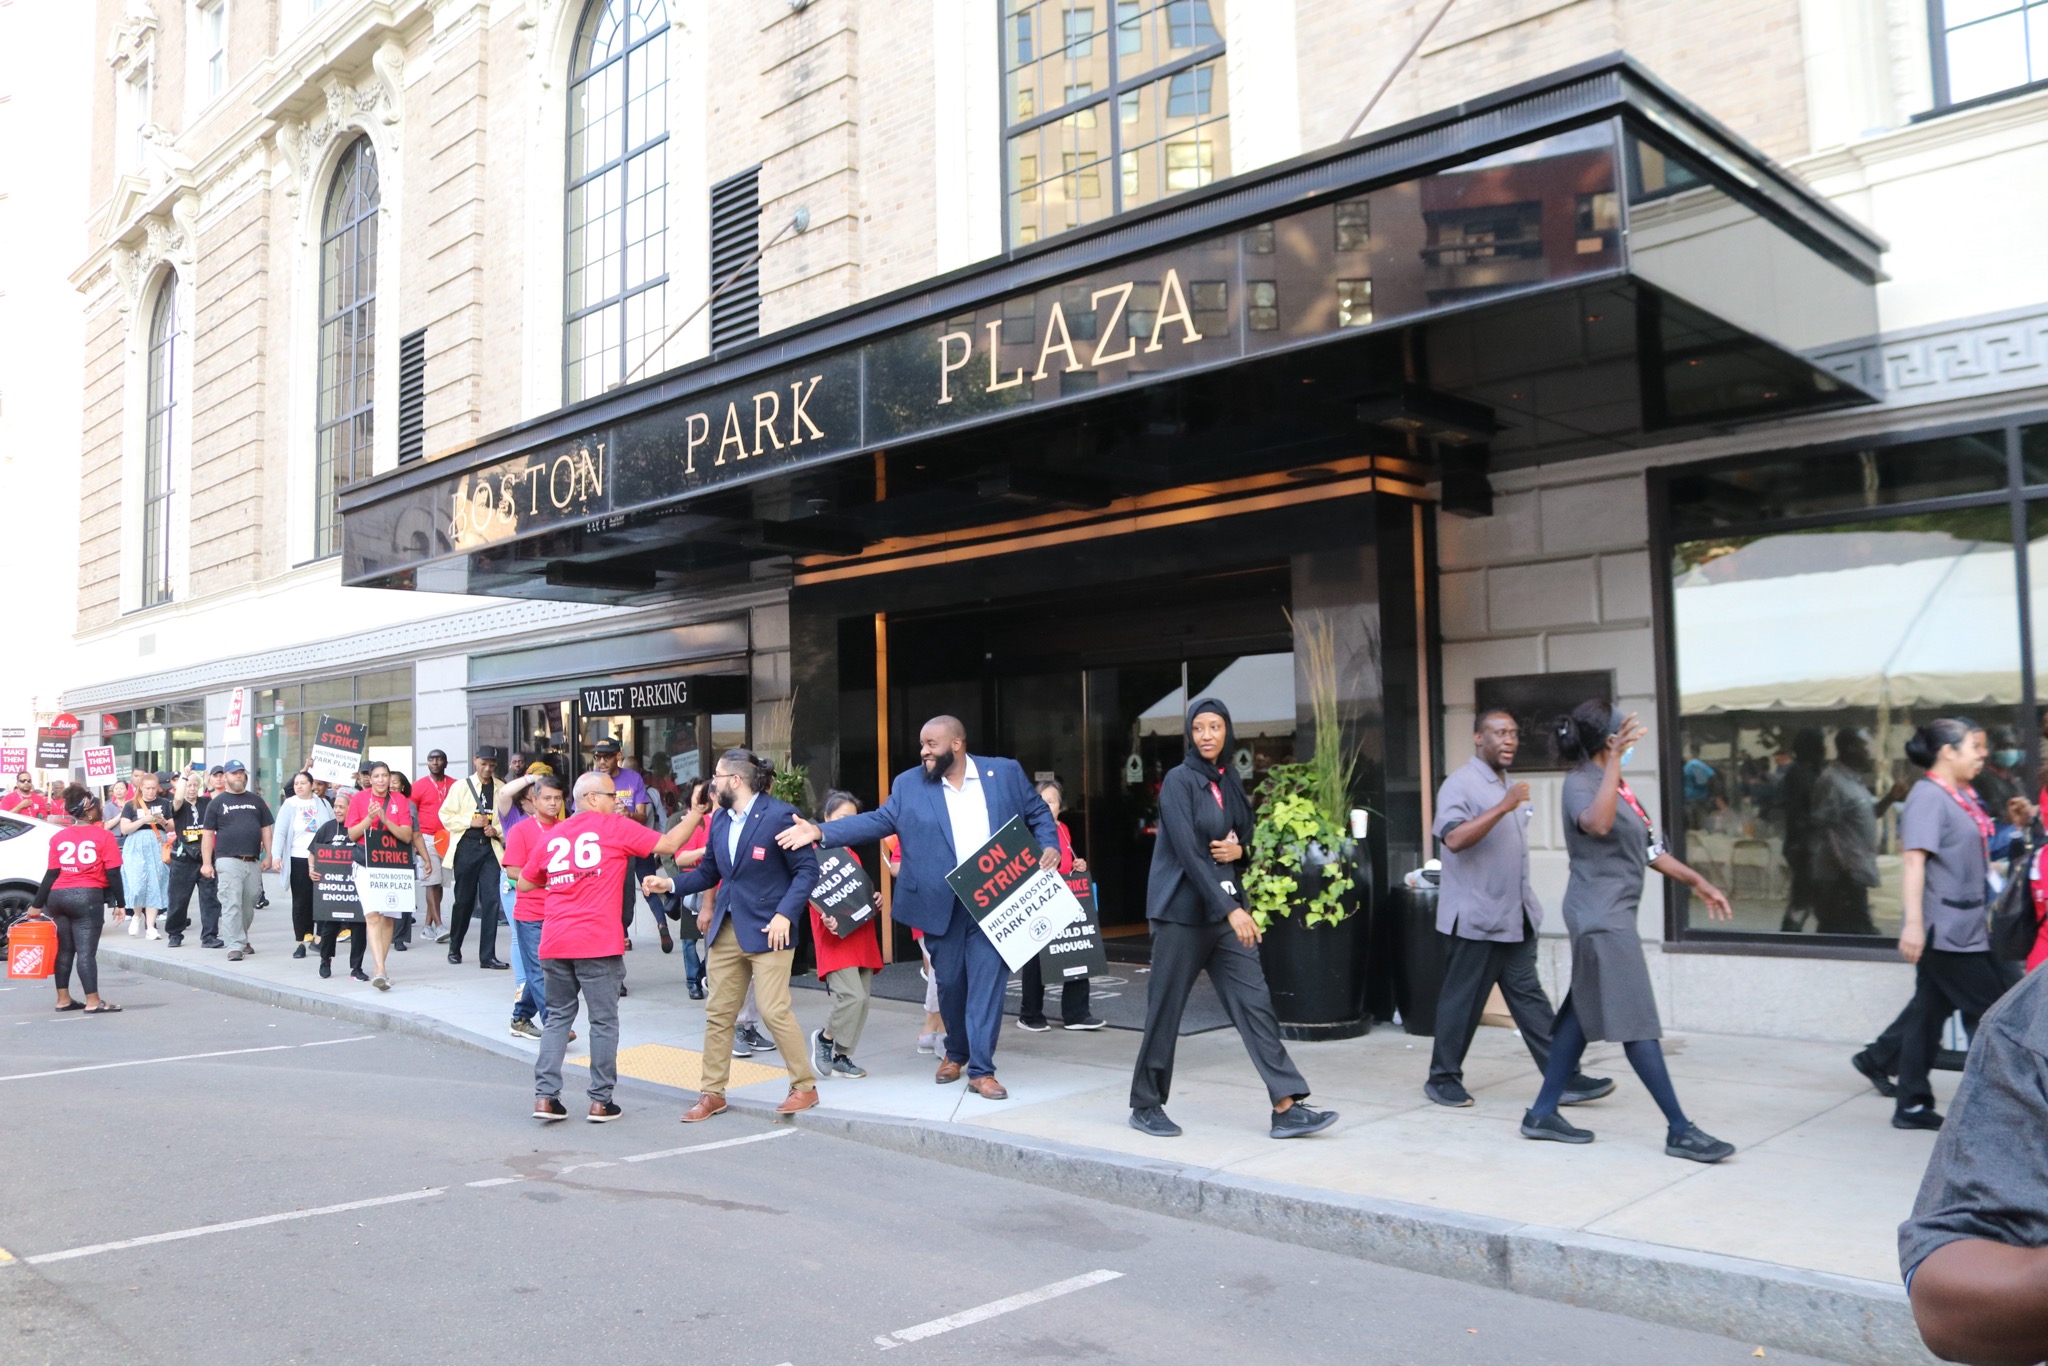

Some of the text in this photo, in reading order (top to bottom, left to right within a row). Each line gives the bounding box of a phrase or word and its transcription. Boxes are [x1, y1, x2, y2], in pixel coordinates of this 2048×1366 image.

[449, 268, 1202, 539] BOSTON PARK PLAZA
[585, 681, 687, 712] VALET PARKING
[335, 723, 351, 735] ON
[321, 732, 359, 749] STRIKE
[3, 764, 24, 772] PAY!
[88, 757, 110, 765] THEM
[314, 756, 356, 769] PARK PLAZA
[90, 765, 112, 775] PAY!
[382, 835, 397, 848] ON
[57, 840, 97, 865] 26
[318, 849, 332, 858] ON
[372, 850, 408, 864] STRIKE
[547, 832, 601, 873] 26
[978, 843, 1007, 873] ON
[820, 856, 840, 875] JOB
[811, 862, 856, 898] SHOULD BE
[973, 847, 1037, 908] STRIKE
[319, 883, 355, 891] SHOULD
[390, 882, 412, 890] PLAZA
[823, 878, 862, 907] ENOUGH.
[988, 872, 1054, 932] HILTON BOSTON
[995, 882, 1062, 943] PARK PLAZA
[1034, 924, 1047, 936] 26
[1082, 925, 1096, 936] BE
[1049, 939, 1094, 955] ENOUGH.
[12, 945, 43, 974] HOME
